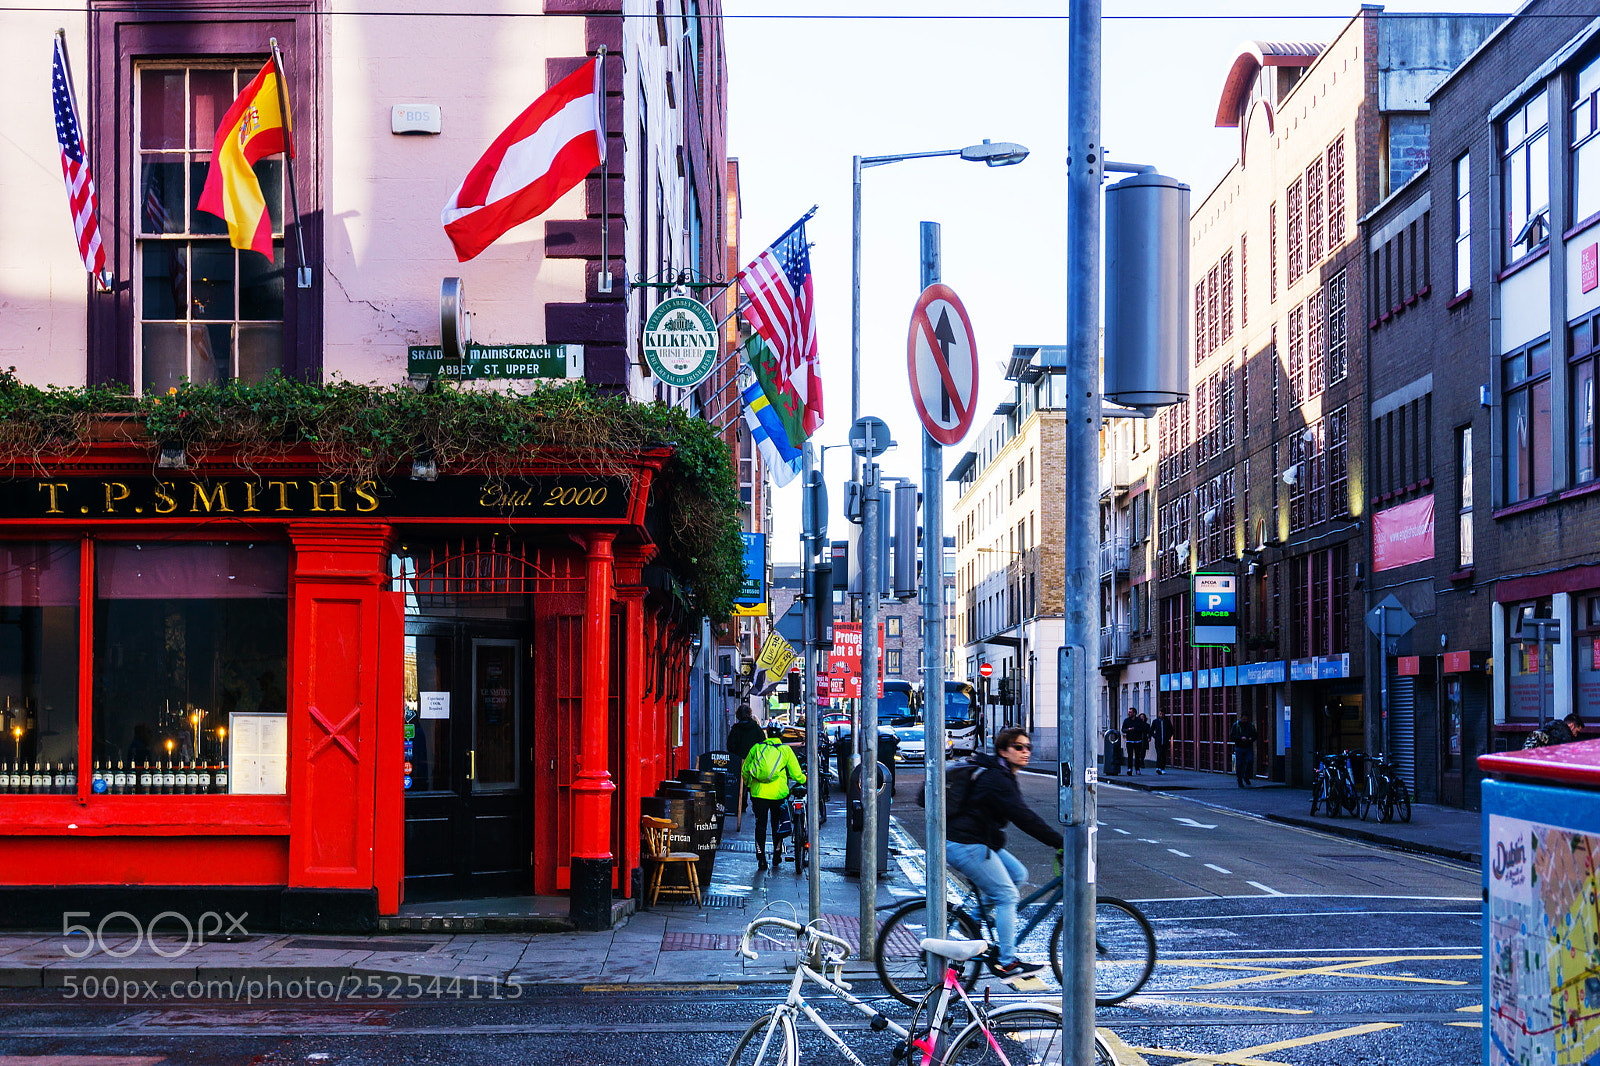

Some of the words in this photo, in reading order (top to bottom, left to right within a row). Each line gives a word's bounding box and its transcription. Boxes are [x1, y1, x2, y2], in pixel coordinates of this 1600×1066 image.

[406, 111, 430, 121] BDS
[645, 332, 717, 347] KILKENNY
[659, 348, 680, 358] IRISH
[682, 348, 702, 358] BEER
[572, 354, 578, 368] 1
[438, 364, 474, 375] ABBEY
[484, 364, 500, 374] ST.
[505, 364, 540, 374] UPPER
[543, 486, 608, 506] 2000
[1208, 594, 1222, 610] P
[835, 631, 862, 645] Protes
[1492, 839, 1527, 880] Dublin
